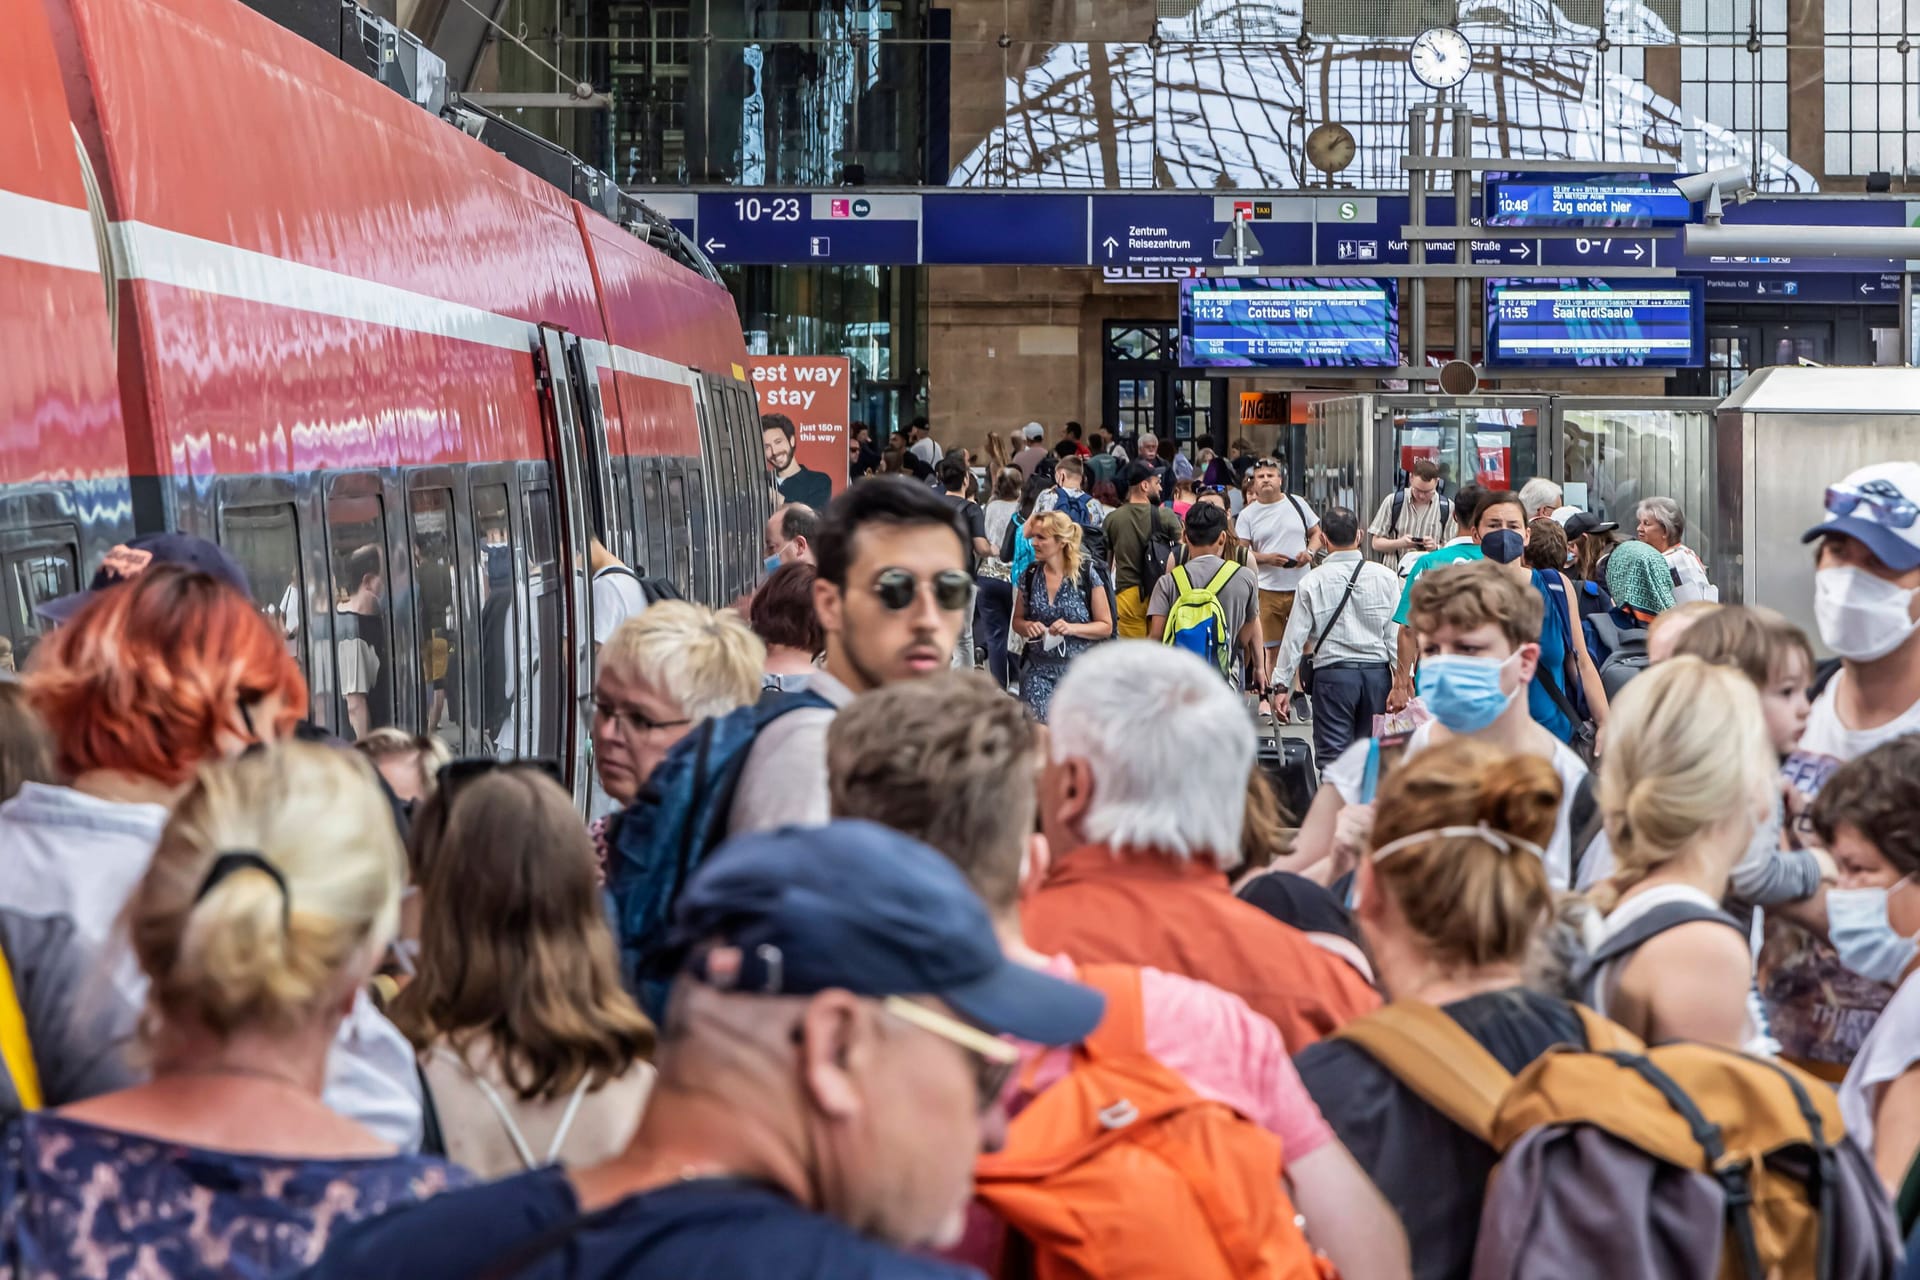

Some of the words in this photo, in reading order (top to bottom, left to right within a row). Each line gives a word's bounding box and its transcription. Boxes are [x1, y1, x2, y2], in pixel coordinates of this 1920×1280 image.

[735, 198, 801, 221] 10-23
[1499, 200, 1529, 212] 10:48
[1552, 200, 1573, 214] Zug
[1576, 201, 1607, 213] endet
[1611, 201, 1632, 212] hier
[1129, 226, 1168, 236] Zentrum
[1128, 238, 1191, 249] Reisezentrum
[1707, 280, 1737, 288] Parkhaus
[1738, 280, 1749, 288] Ost
[1194, 307, 1224, 318] 11:12
[1248, 307, 1291, 318] Cottbus
[1294, 307, 1313, 318] Hbf
[1499, 307, 1529, 318] 11:55
[1552, 307, 1634, 319] Saalfeld(Saale)
[793, 367, 843, 387] way
[767, 386, 816, 410] stay
[800, 422, 817, 433] just
[800, 433, 816, 443] this
[818, 436, 836, 446] way
